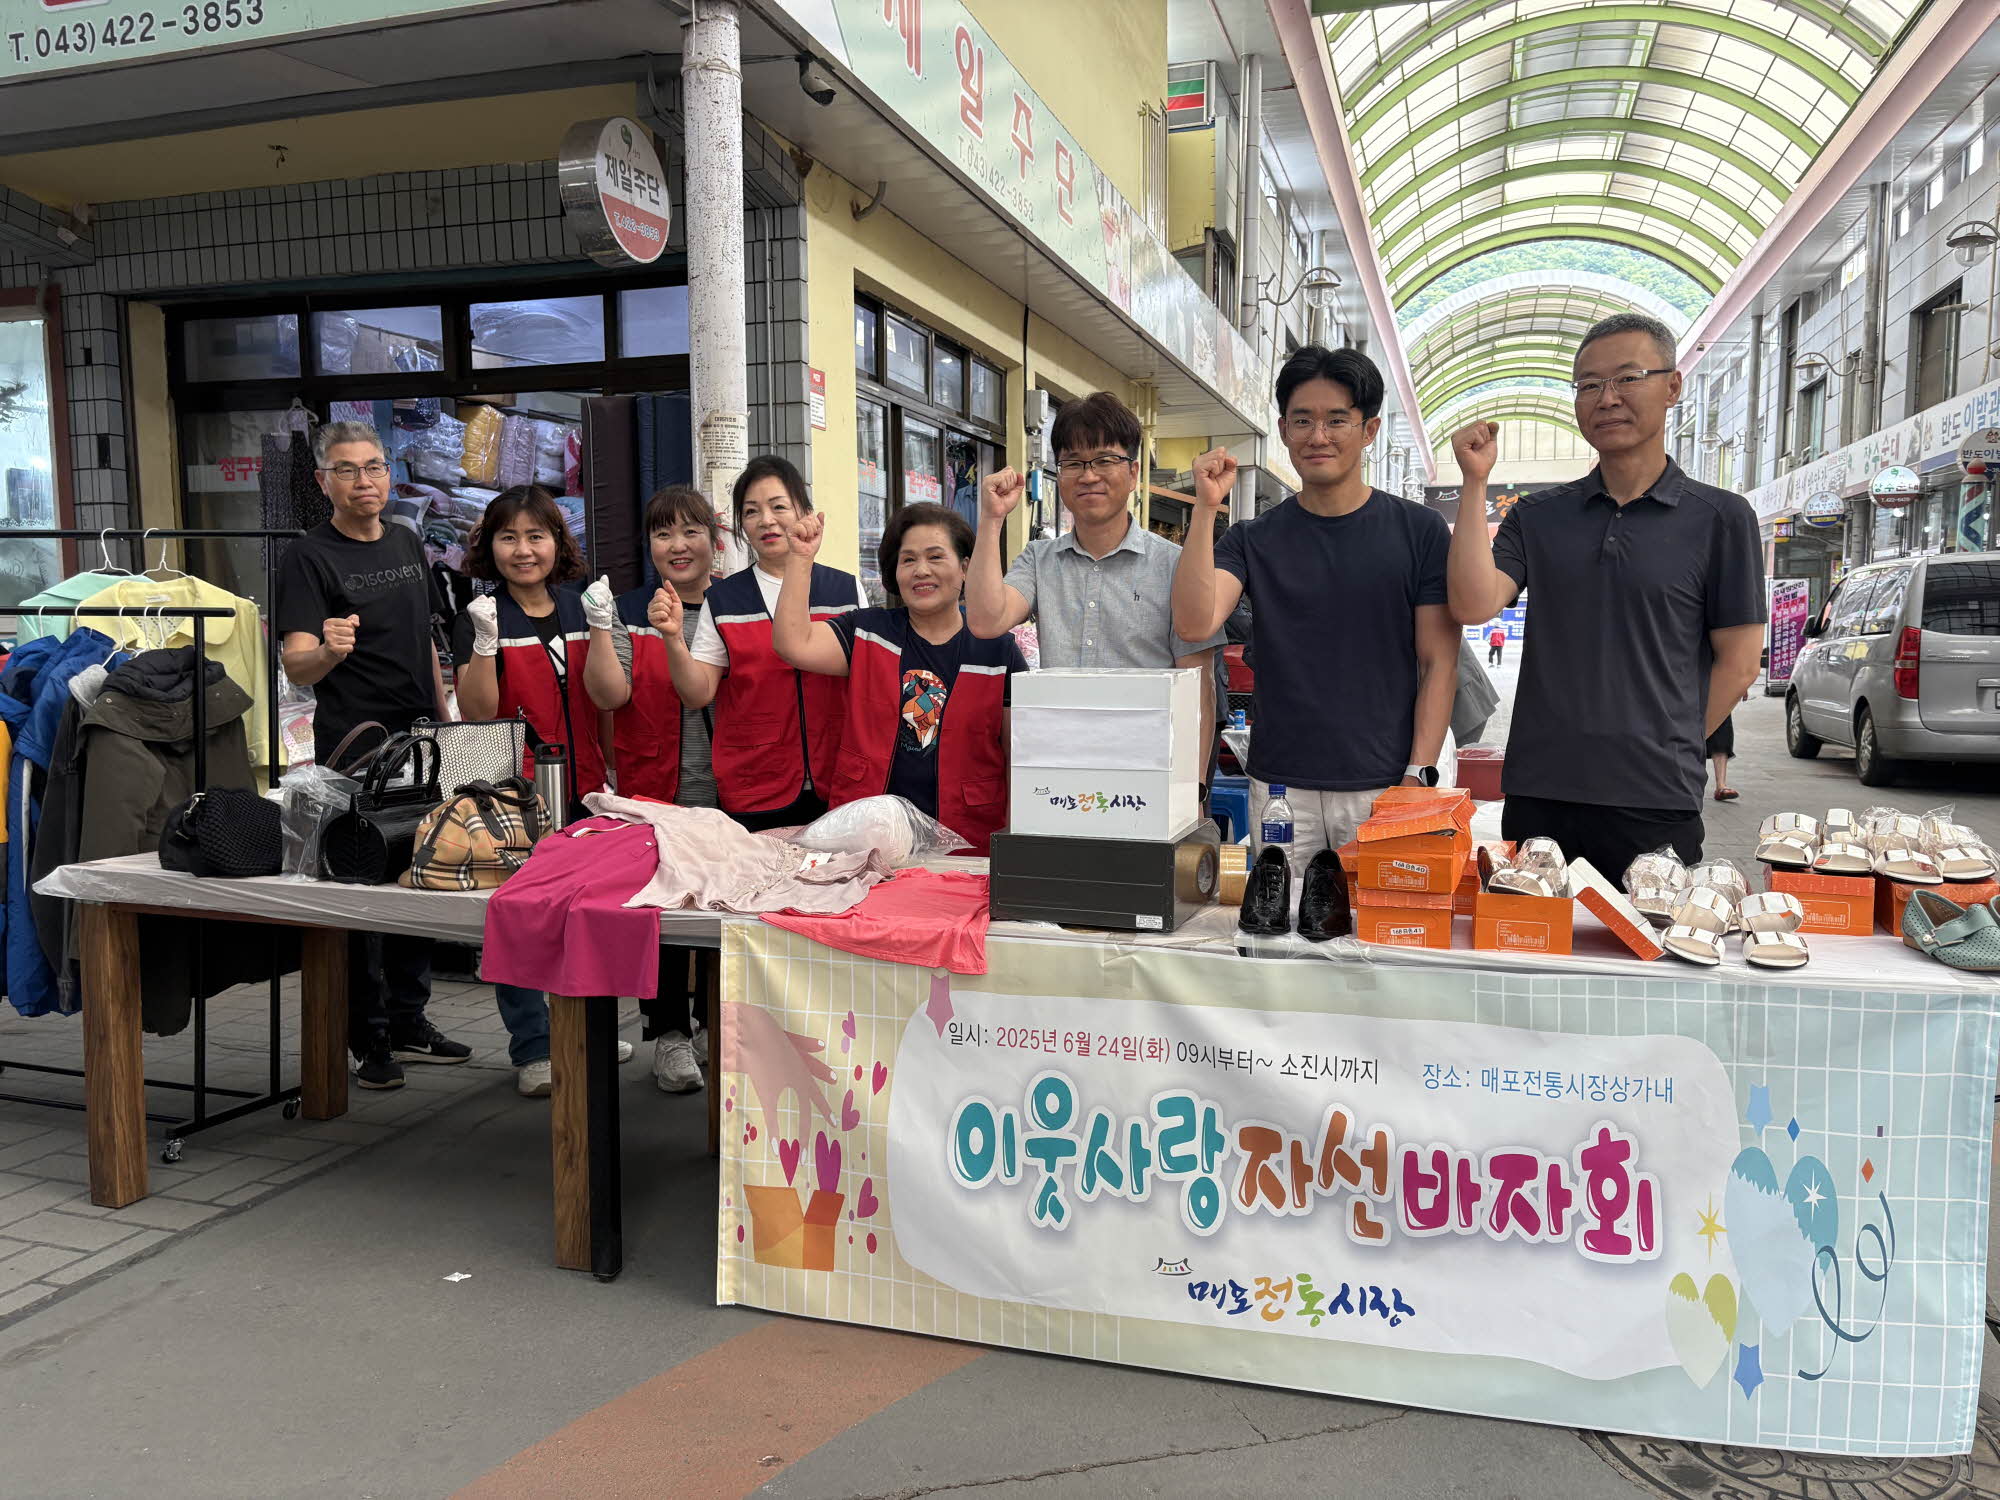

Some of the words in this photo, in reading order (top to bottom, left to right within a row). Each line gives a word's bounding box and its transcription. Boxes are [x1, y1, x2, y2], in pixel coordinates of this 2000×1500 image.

[604, 152, 660, 206] 제일주단
[1874, 482, 1919, 494] 장수순대
[1050, 791, 1147, 814] 매포전통시장
[948, 1021, 989, 1047] 일시:
[996, 1026, 1058, 1054] 2025년
[1063, 1032, 1092, 1057] 6월
[1097, 1035, 1171, 1065] 24일(화)
[1280, 1052, 1380, 1085] 소진시까지
[1422, 1063, 1470, 1090] 장소:
[1481, 1066, 1674, 1104] 매포전통시장상가내
[1187, 1272, 1416, 1328] 매포전통시장
